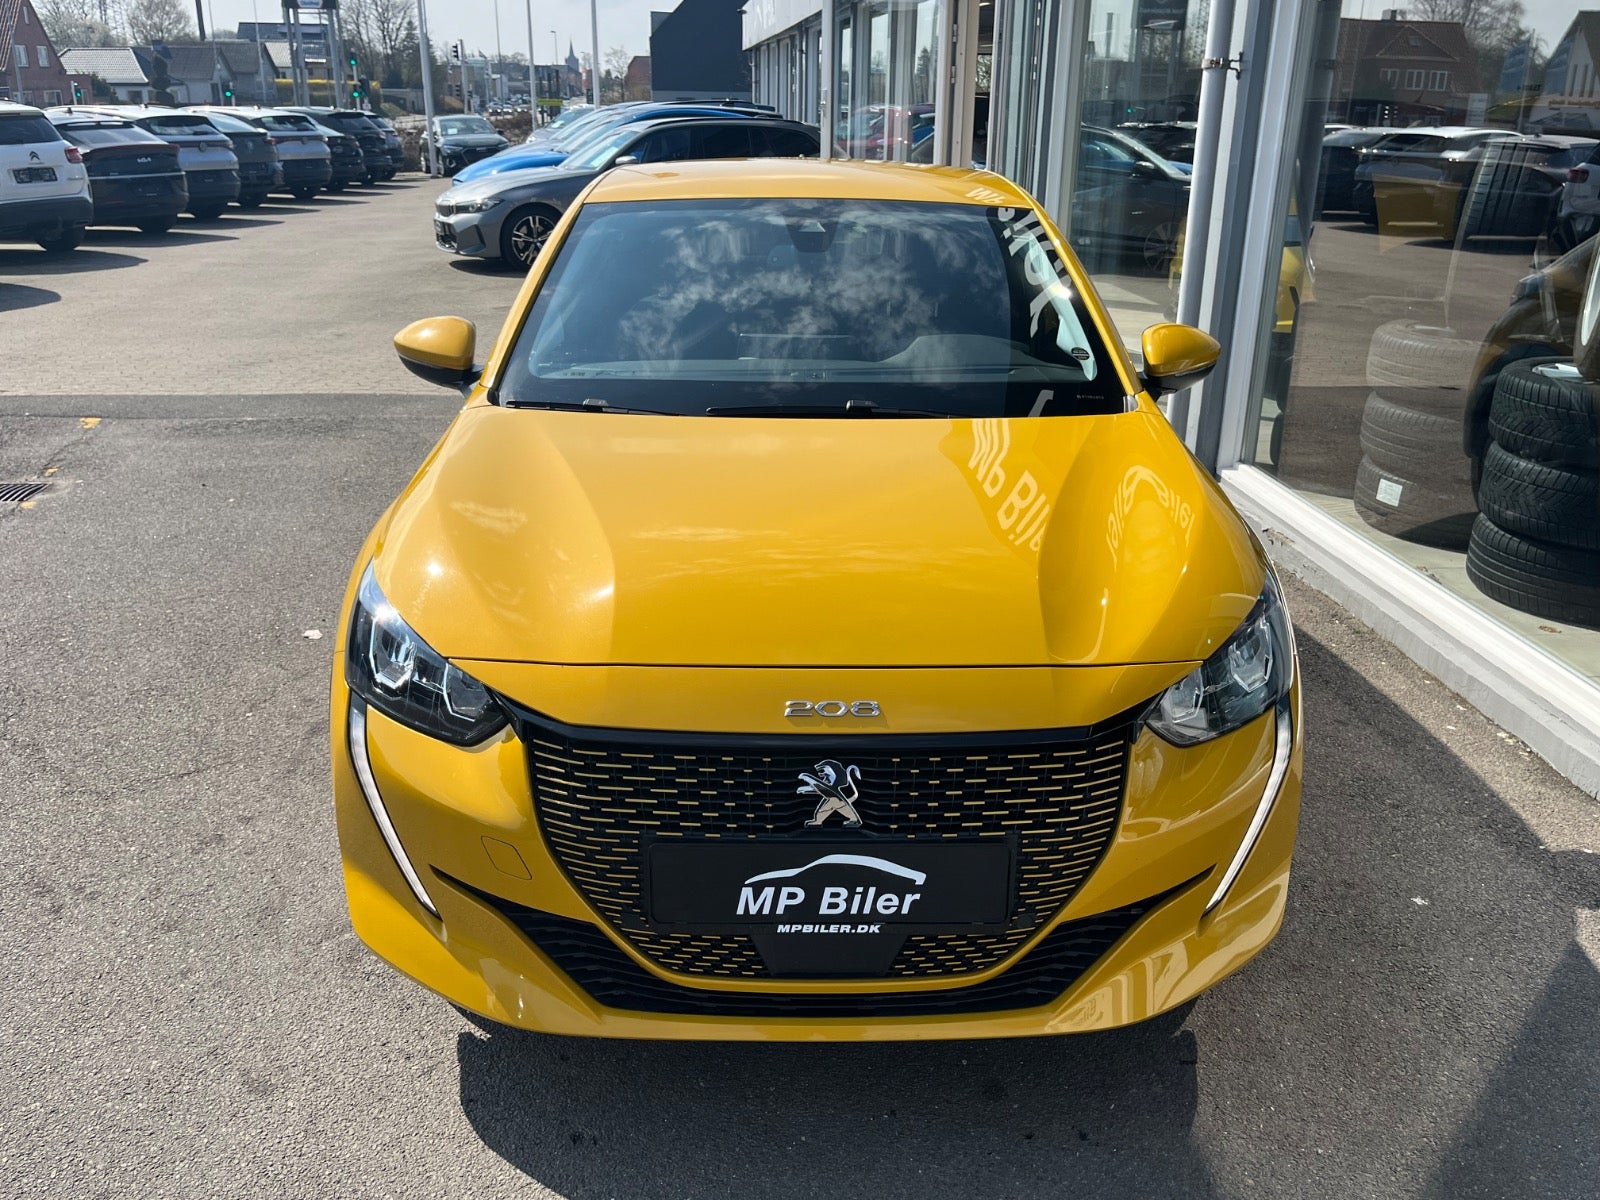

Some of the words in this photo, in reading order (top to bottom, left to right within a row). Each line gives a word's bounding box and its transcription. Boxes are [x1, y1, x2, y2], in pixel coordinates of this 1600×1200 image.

[784, 700, 881, 717] 208
[736, 886, 805, 915] MP
[818, 886, 920, 915] Biler
[777, 924, 881, 934] MPBILER.DK
